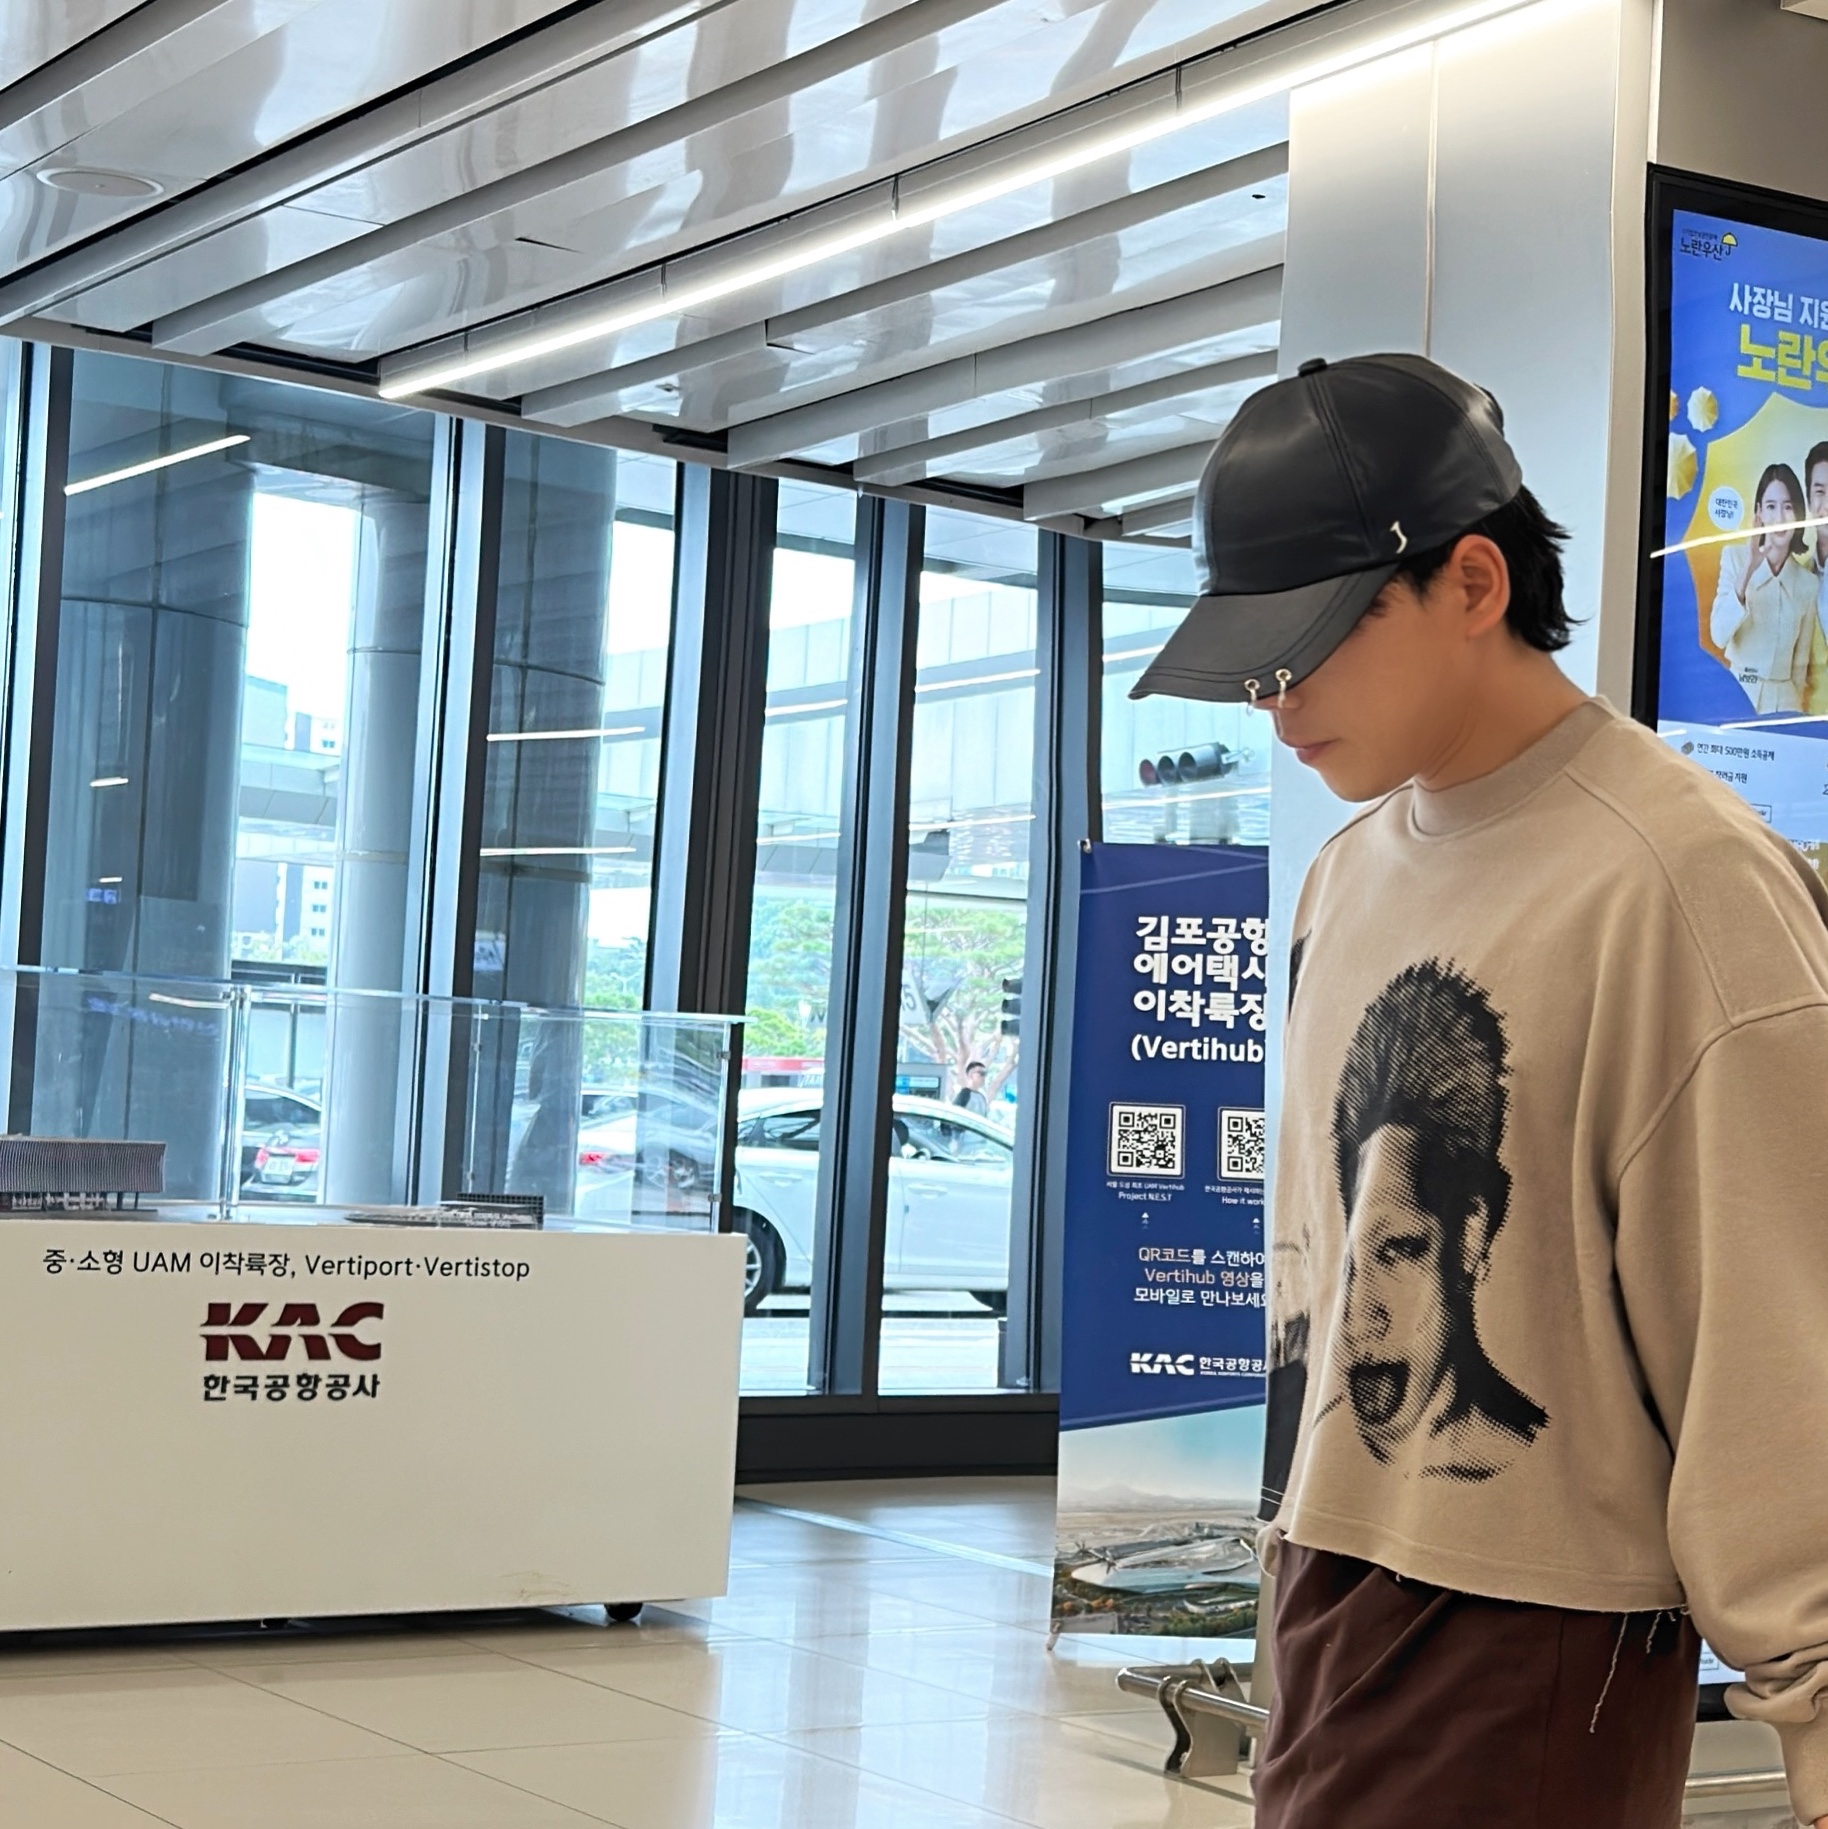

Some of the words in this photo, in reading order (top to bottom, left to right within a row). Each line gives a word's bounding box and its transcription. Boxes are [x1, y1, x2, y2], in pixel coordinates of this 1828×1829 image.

[1680, 237, 1723, 261] 노란우산
[1729, 285, 1793, 323] 사장님
[1136, 915, 1268, 956] 김포공항
[1118, 1192, 1146, 1202] Project
[43, 1249, 123, 1275] 중·소형
[133, 1252, 191, 1273] UAM
[200, 1252, 296, 1279] 이착륙장,
[1138, 1247, 1206, 1265] QR코드를
[1145, 1268, 1215, 1285] Vertihub
[1220, 1271, 1264, 1288] 영상을
[1134, 1287, 1196, 1305] 모바일로
[200, 1302, 384, 1361] KAC
[1130, 1352, 1195, 1376] KAC
[203, 1373, 381, 1401] 한국공항공사
